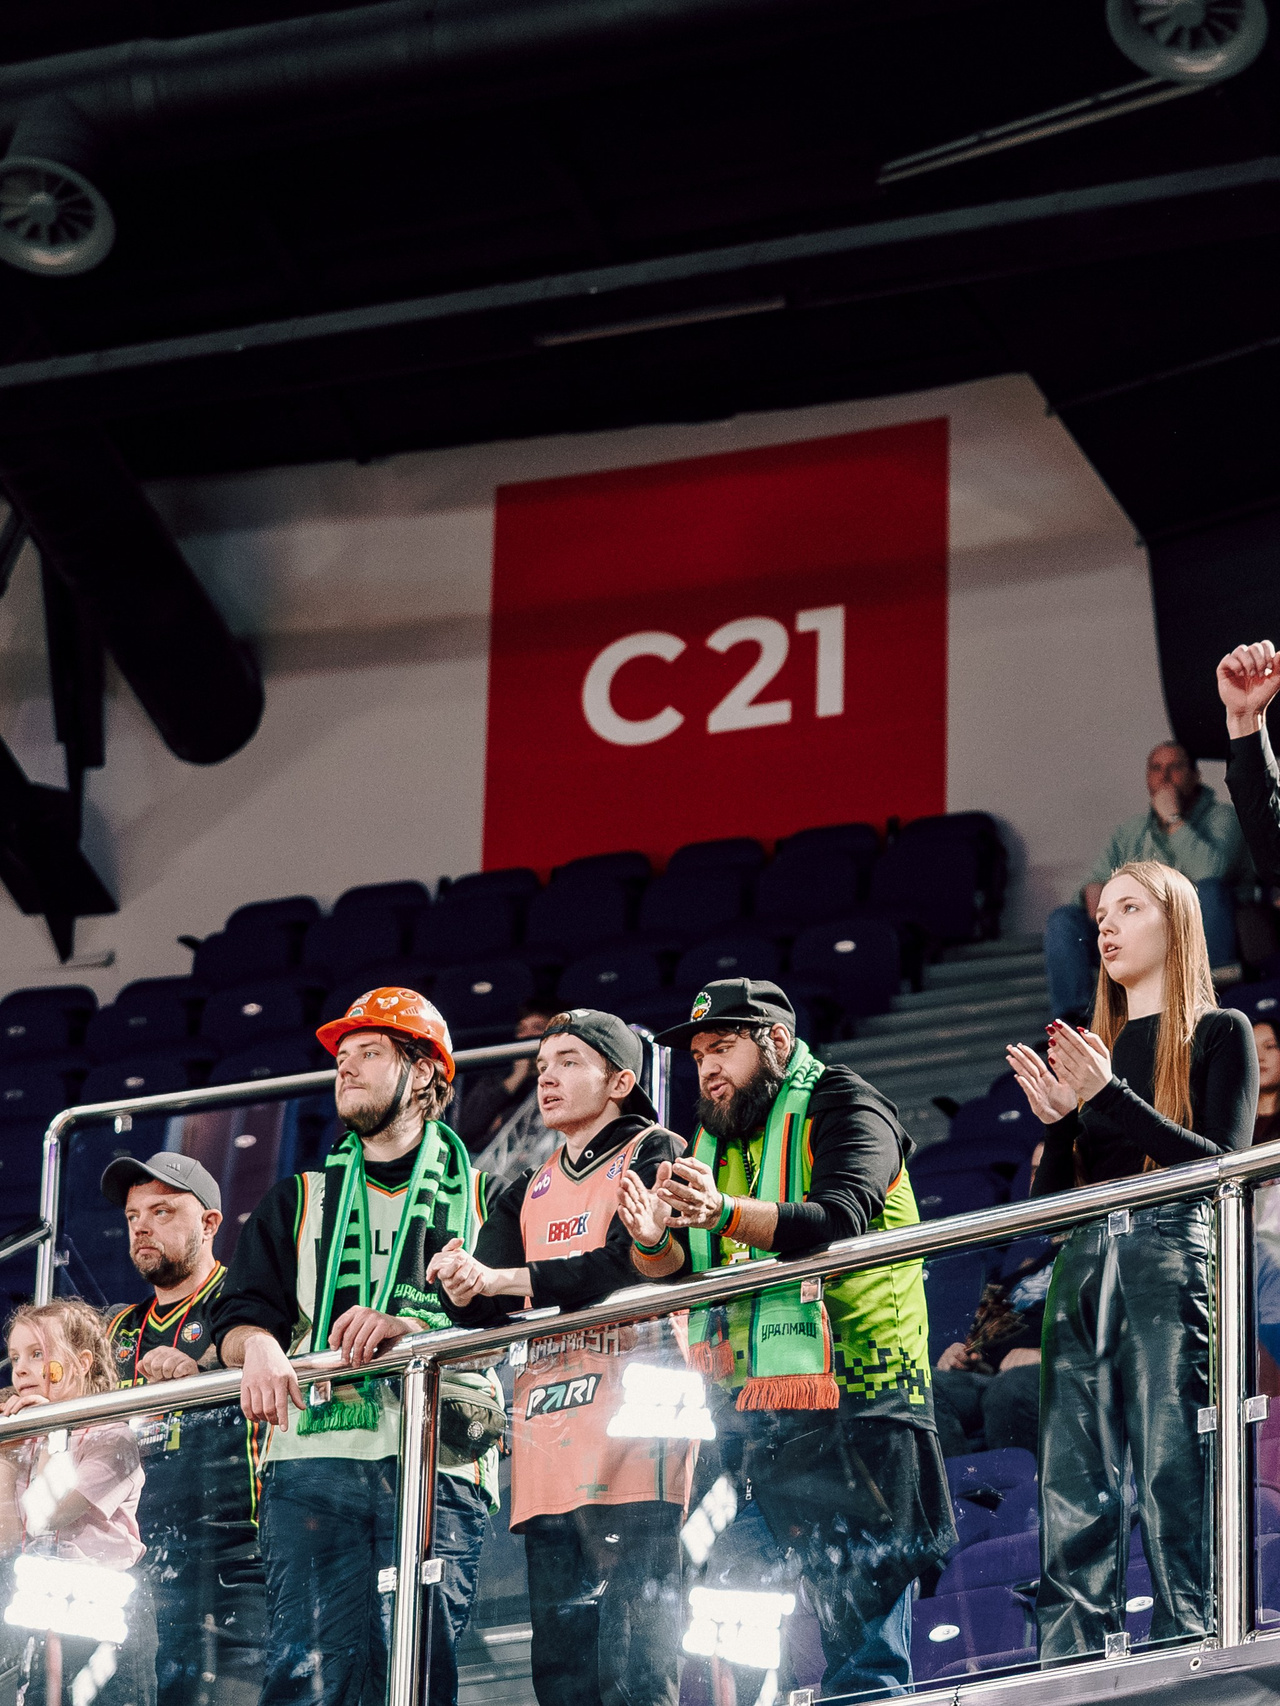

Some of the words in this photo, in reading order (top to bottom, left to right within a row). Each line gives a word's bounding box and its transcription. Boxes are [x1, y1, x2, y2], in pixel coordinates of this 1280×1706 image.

[581, 603, 846, 746] C21
[394, 1283, 441, 1306] УРАЛМА
[761, 1321, 818, 1343] УРАЛМАШ
